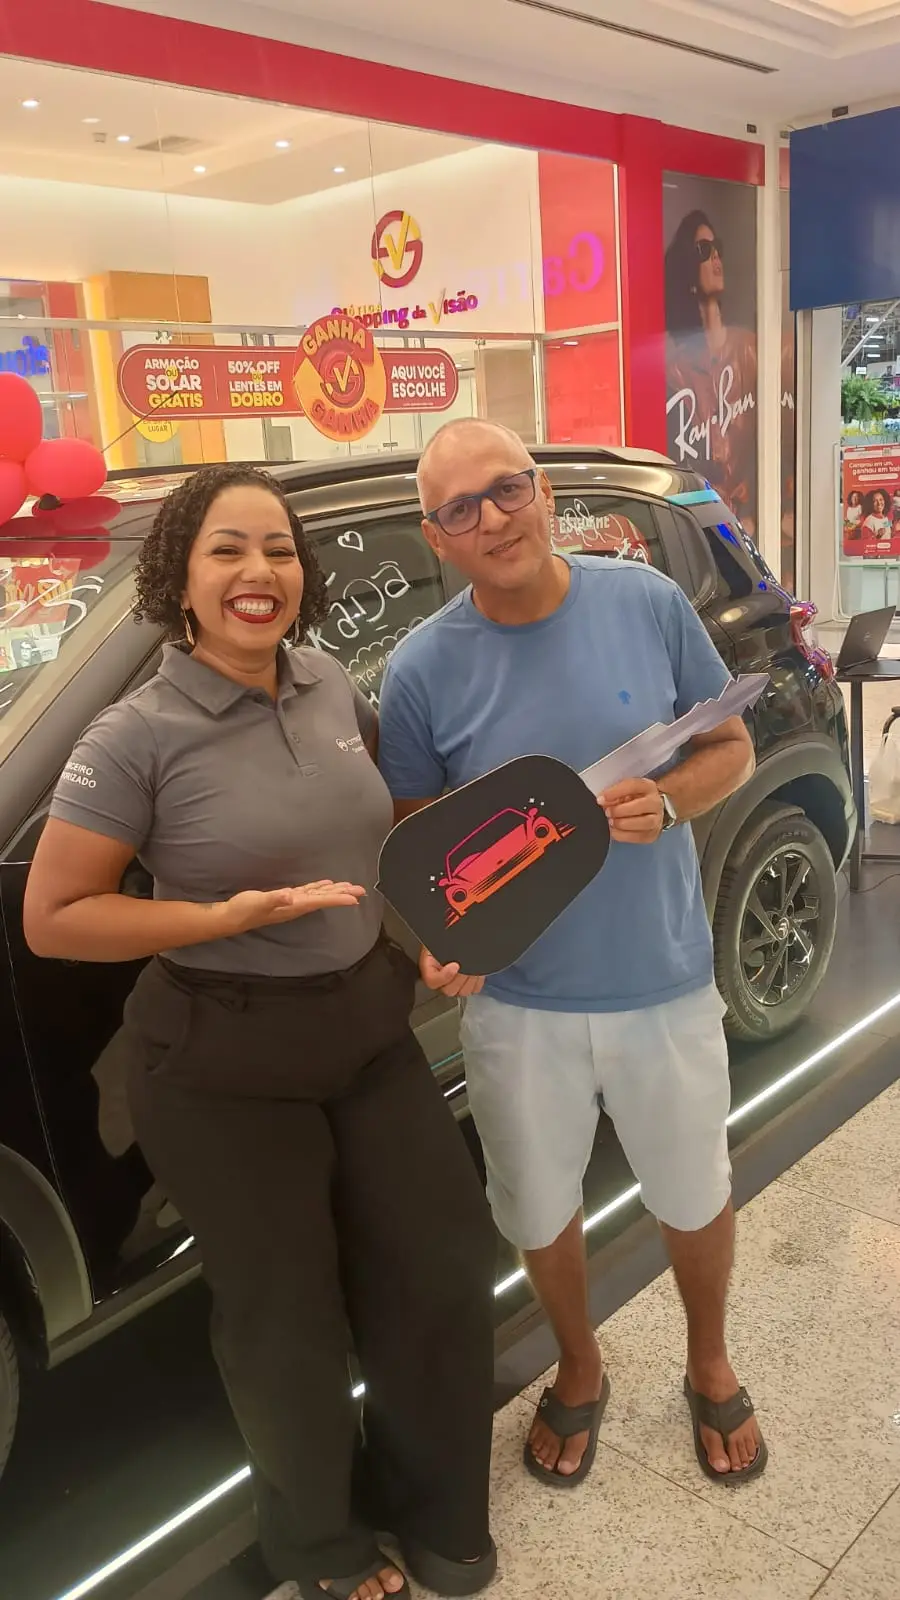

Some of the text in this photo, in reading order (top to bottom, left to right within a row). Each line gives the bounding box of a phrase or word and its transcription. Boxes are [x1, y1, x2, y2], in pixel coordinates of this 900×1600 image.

[412, 305, 427, 320] da
[428, 289, 478, 324] Visão
[302, 319, 366, 355] GANHA
[145, 356, 199, 372] ARMAÇÃO
[227, 360, 280, 374] 50% OFF
[391, 361, 446, 381] AQUI VOCÊ
[166, 369, 178, 377] OU
[146, 374, 202, 391] SOLAR
[229, 380, 283, 392] LENTES EM
[392, 382, 447, 398] ESCOLHE
[230, 392, 284, 407] DOBRO
[311, 398, 379, 434] GANHA
[147, 425, 169, 433] LUGAR
